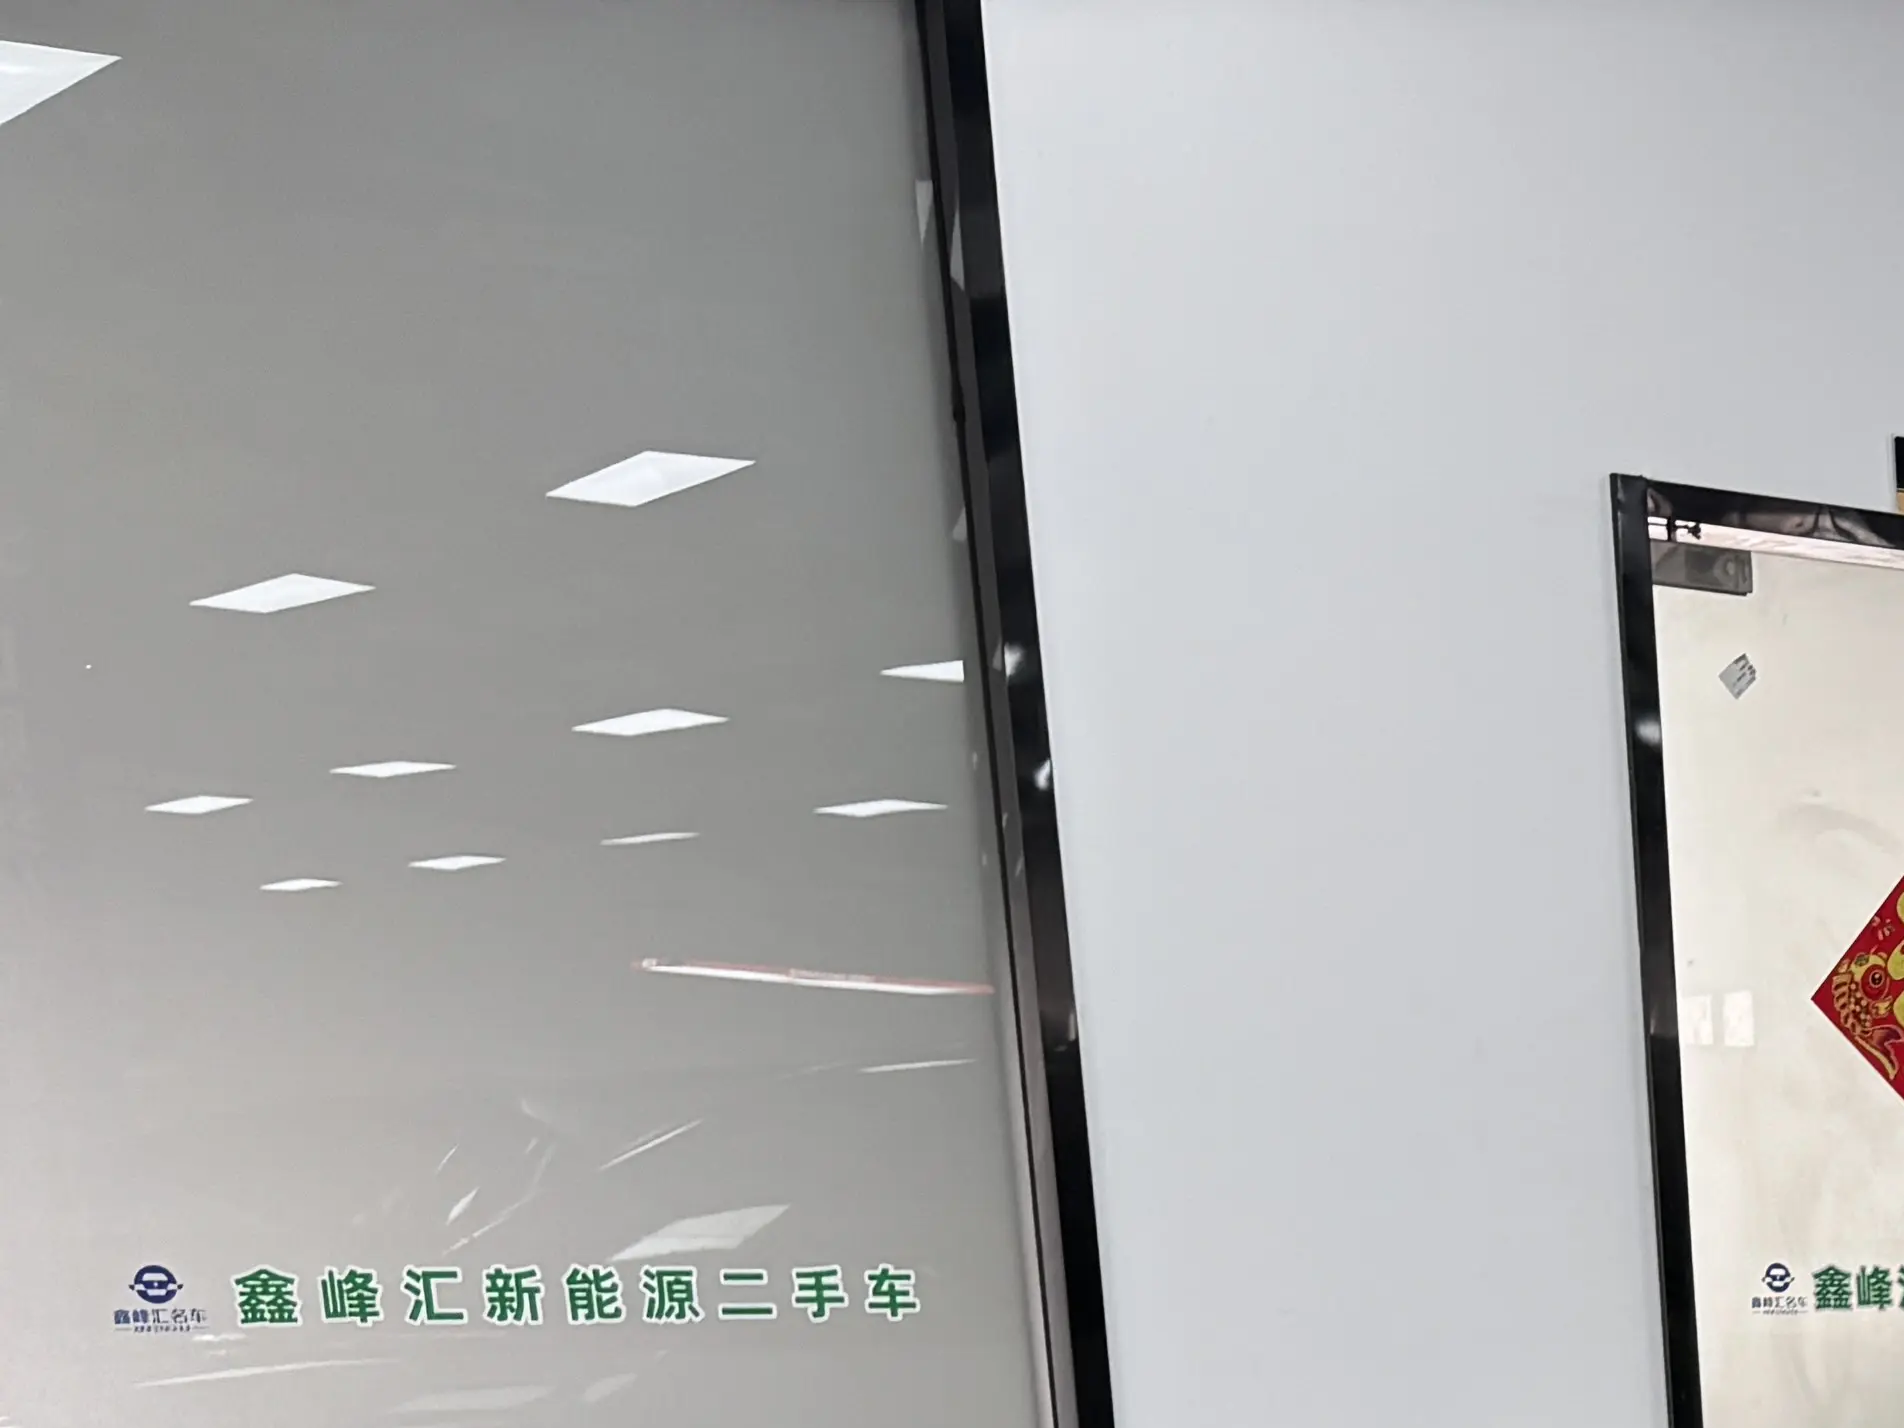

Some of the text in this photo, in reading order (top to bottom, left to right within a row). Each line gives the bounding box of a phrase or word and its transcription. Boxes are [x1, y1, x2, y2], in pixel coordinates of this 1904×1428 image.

[233, 1267, 919, 1325] 鑫峰汇新能源二手车
